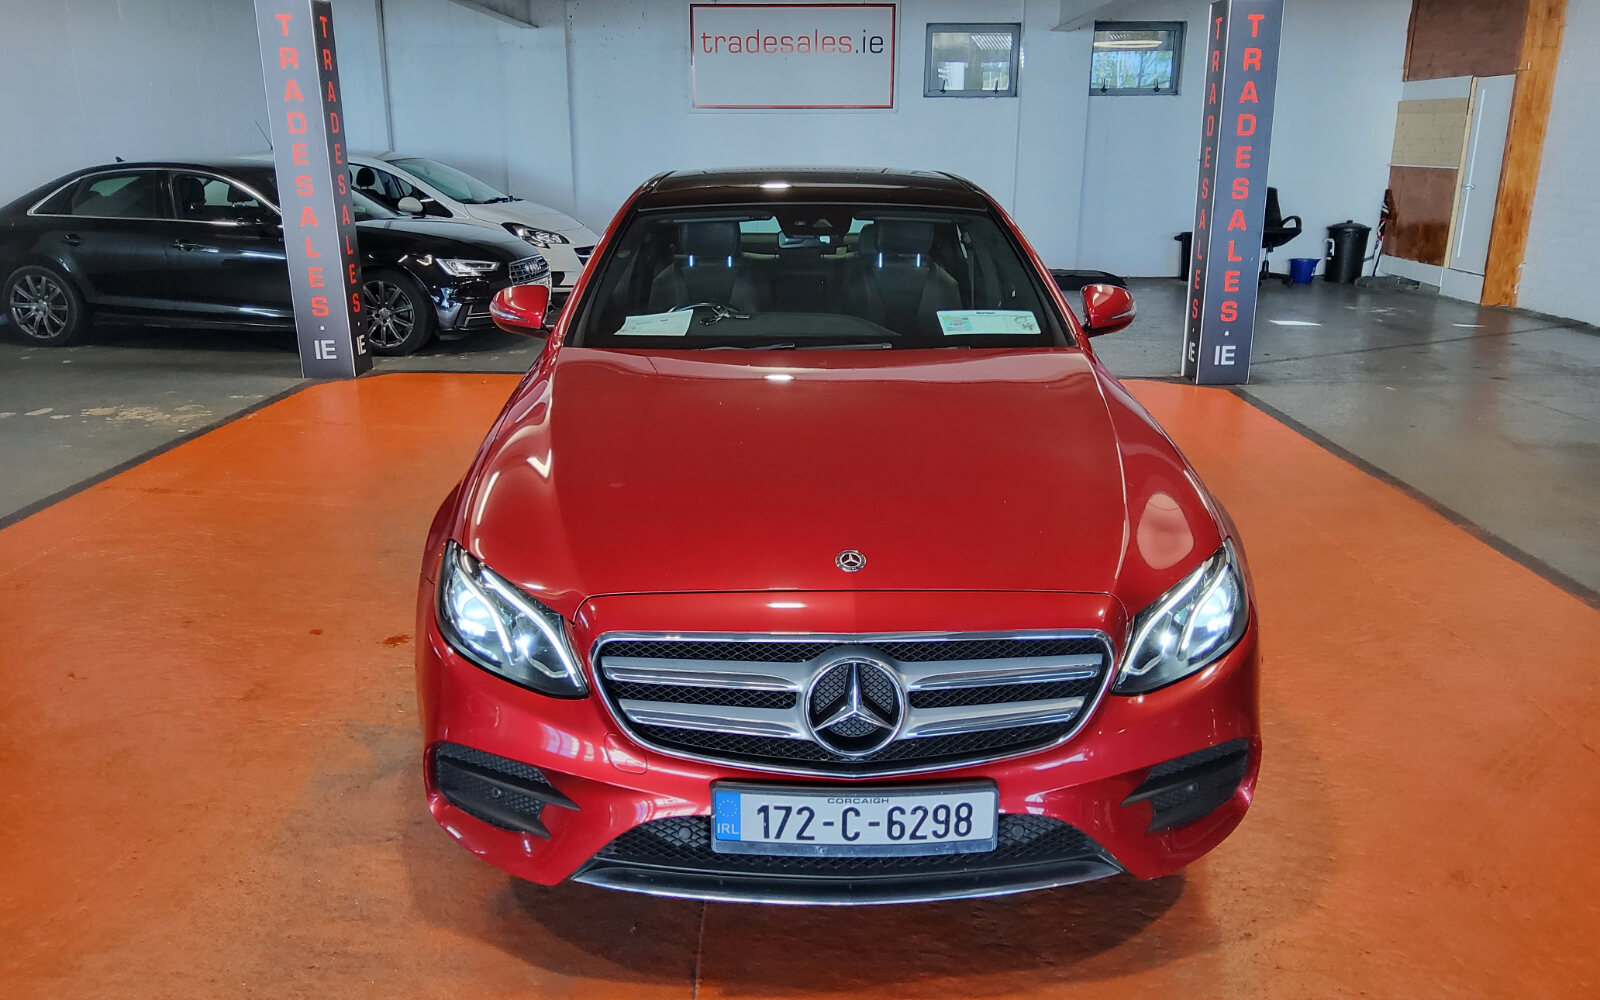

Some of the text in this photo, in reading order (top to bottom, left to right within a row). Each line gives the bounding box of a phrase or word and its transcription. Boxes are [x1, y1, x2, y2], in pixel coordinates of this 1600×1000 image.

[701, 29, 884, 54] tradesales.ie
[717, 822, 740, 835] IRL
[756, 802, 974, 842] 172-C-6298
